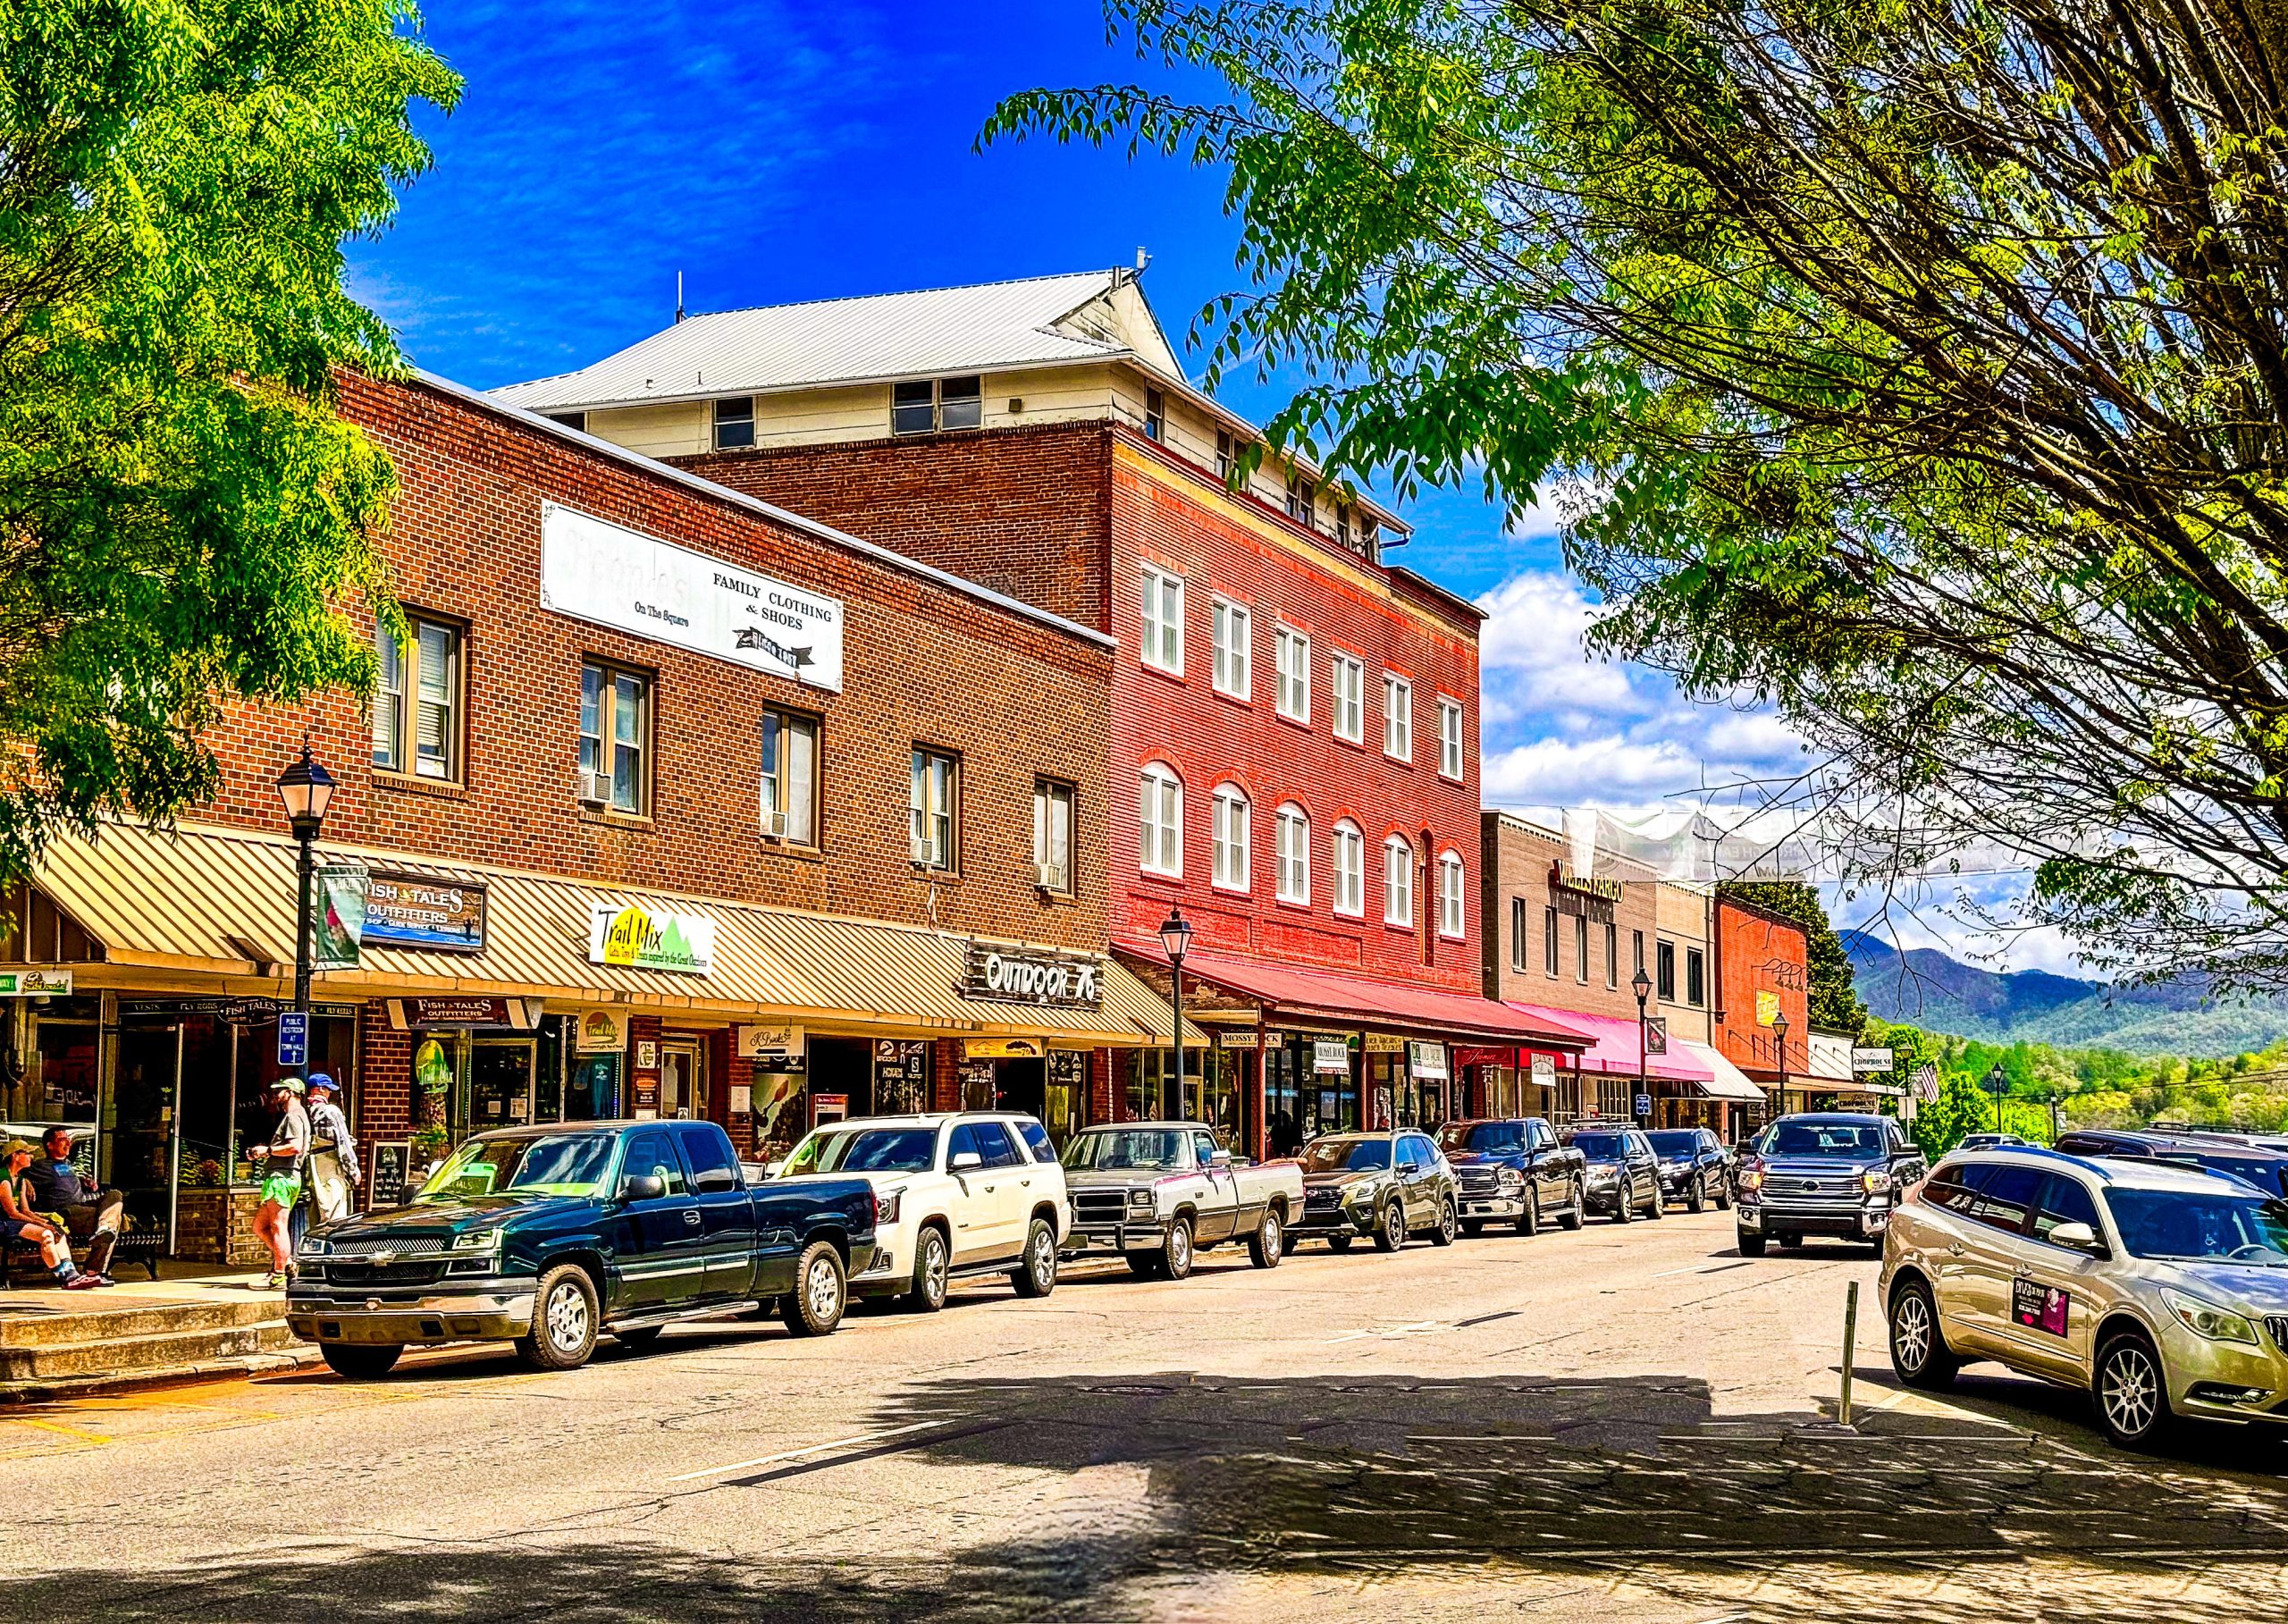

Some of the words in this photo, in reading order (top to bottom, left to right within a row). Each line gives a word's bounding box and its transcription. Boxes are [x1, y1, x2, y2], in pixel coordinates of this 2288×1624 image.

[713, 573, 761, 599] FAMILY
[769, 593, 832, 622] CLOTHING
[635, 601, 647, 614] On
[647, 605, 662, 618] The
[663, 610, 689, 627] Square
[746, 605, 758, 615] &
[761, 608, 803, 630] SHOES
[1558, 859, 1593, 891] WELLS
[1594, 869, 1623, 903] FARGO
[409, 888, 464, 914] TALES
[367, 904, 449, 924] OUTFITTERS
[598, 909, 634, 949] Trail
[635, 916, 663, 950] Mix
[985, 953, 1068, 997] OUTDOOR
[1075, 964, 1096, 1002] 76
[225, 1006, 246, 1015] FISH
[248, 1000, 277, 1012] TALES
[417, 999, 446, 1012] FISH
[453, 998, 492, 1012] TALES
[290, 1034, 297, 1042] AT
[1224, 1034, 1253, 1042] MOSSY
[1254, 1034, 1279, 1043] CK
[1332, 1048, 1346, 1058] ROCK
